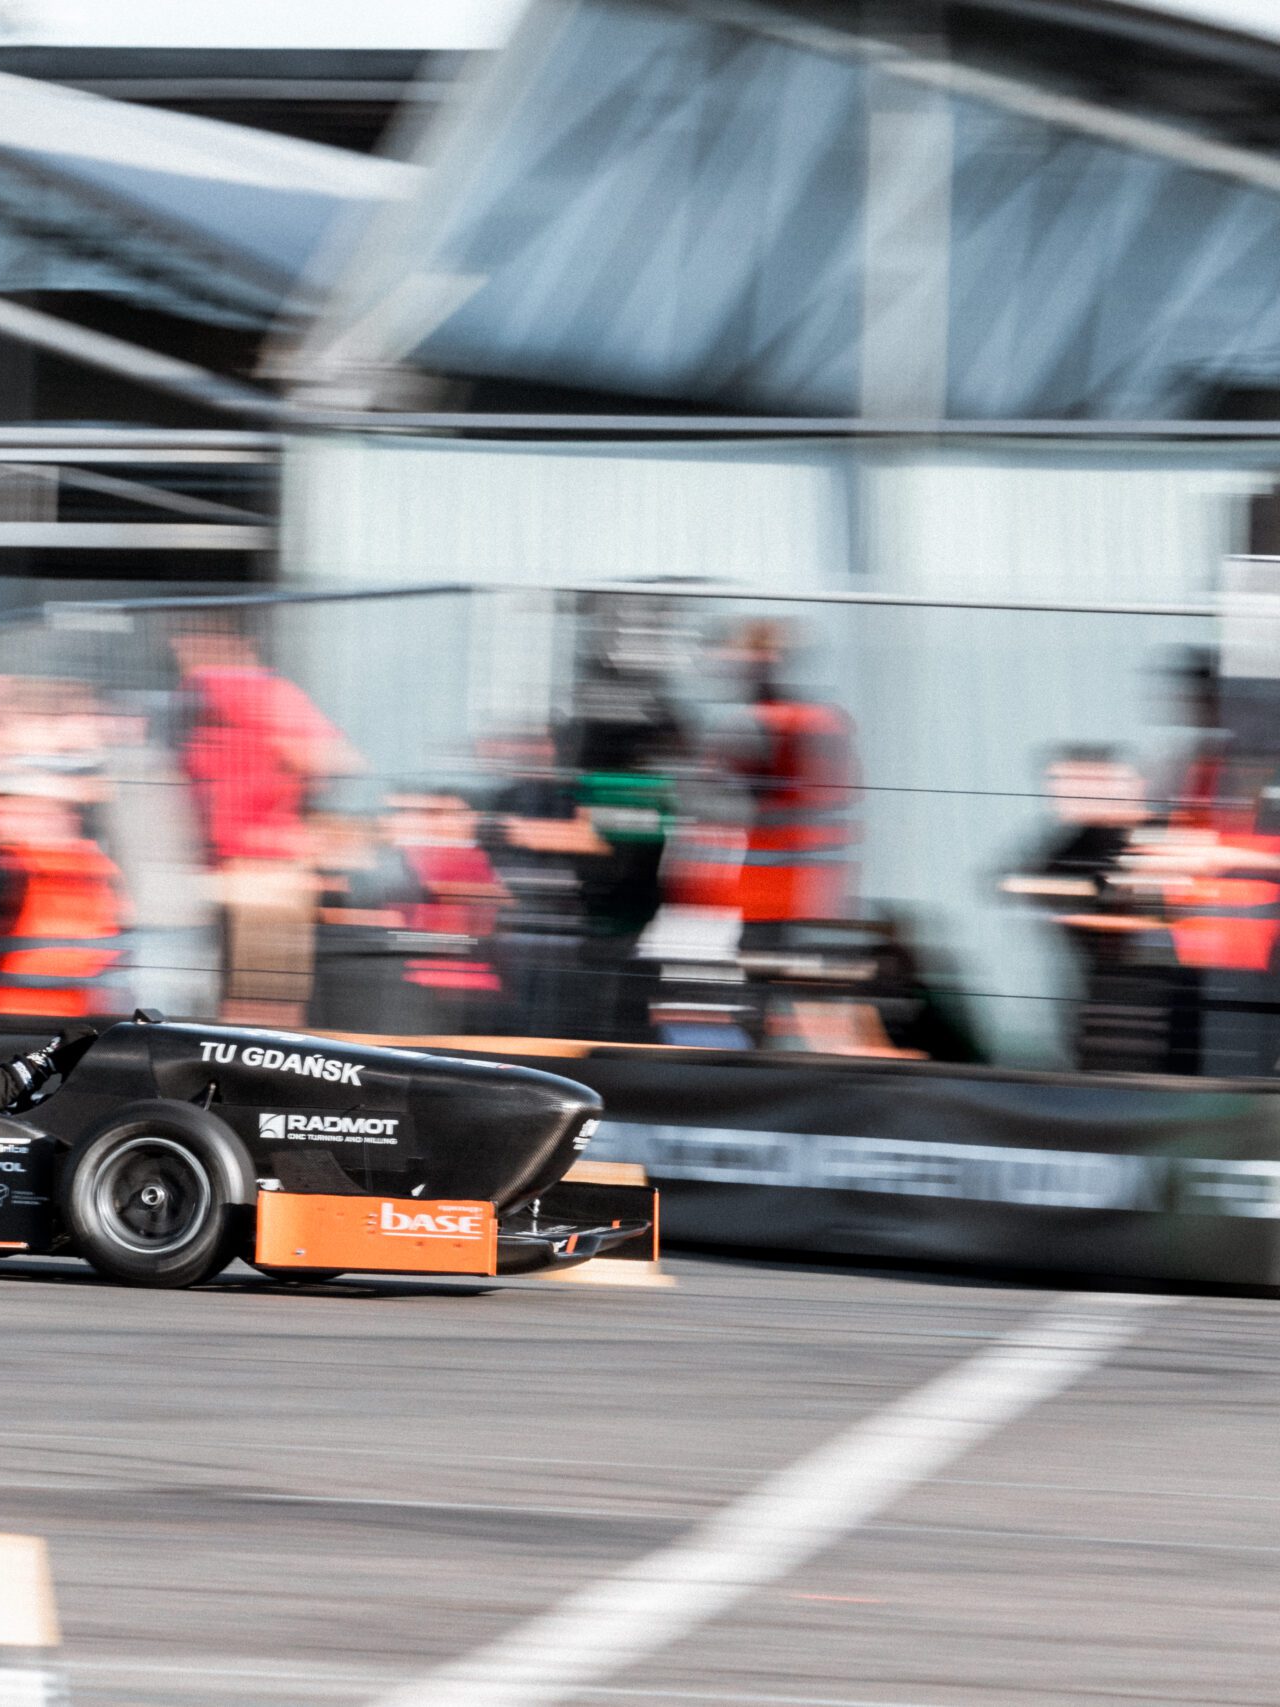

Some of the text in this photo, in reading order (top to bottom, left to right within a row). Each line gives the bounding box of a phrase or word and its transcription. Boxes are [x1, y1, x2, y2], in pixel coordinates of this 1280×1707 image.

[200, 1041, 366, 1087] TU GDAŃSK
[287, 1115, 399, 1135] RADMOT
[287, 1132, 306, 1142] CNC
[307, 1133, 343, 1144] TURNING
[343, 1135, 363, 1144] AND
